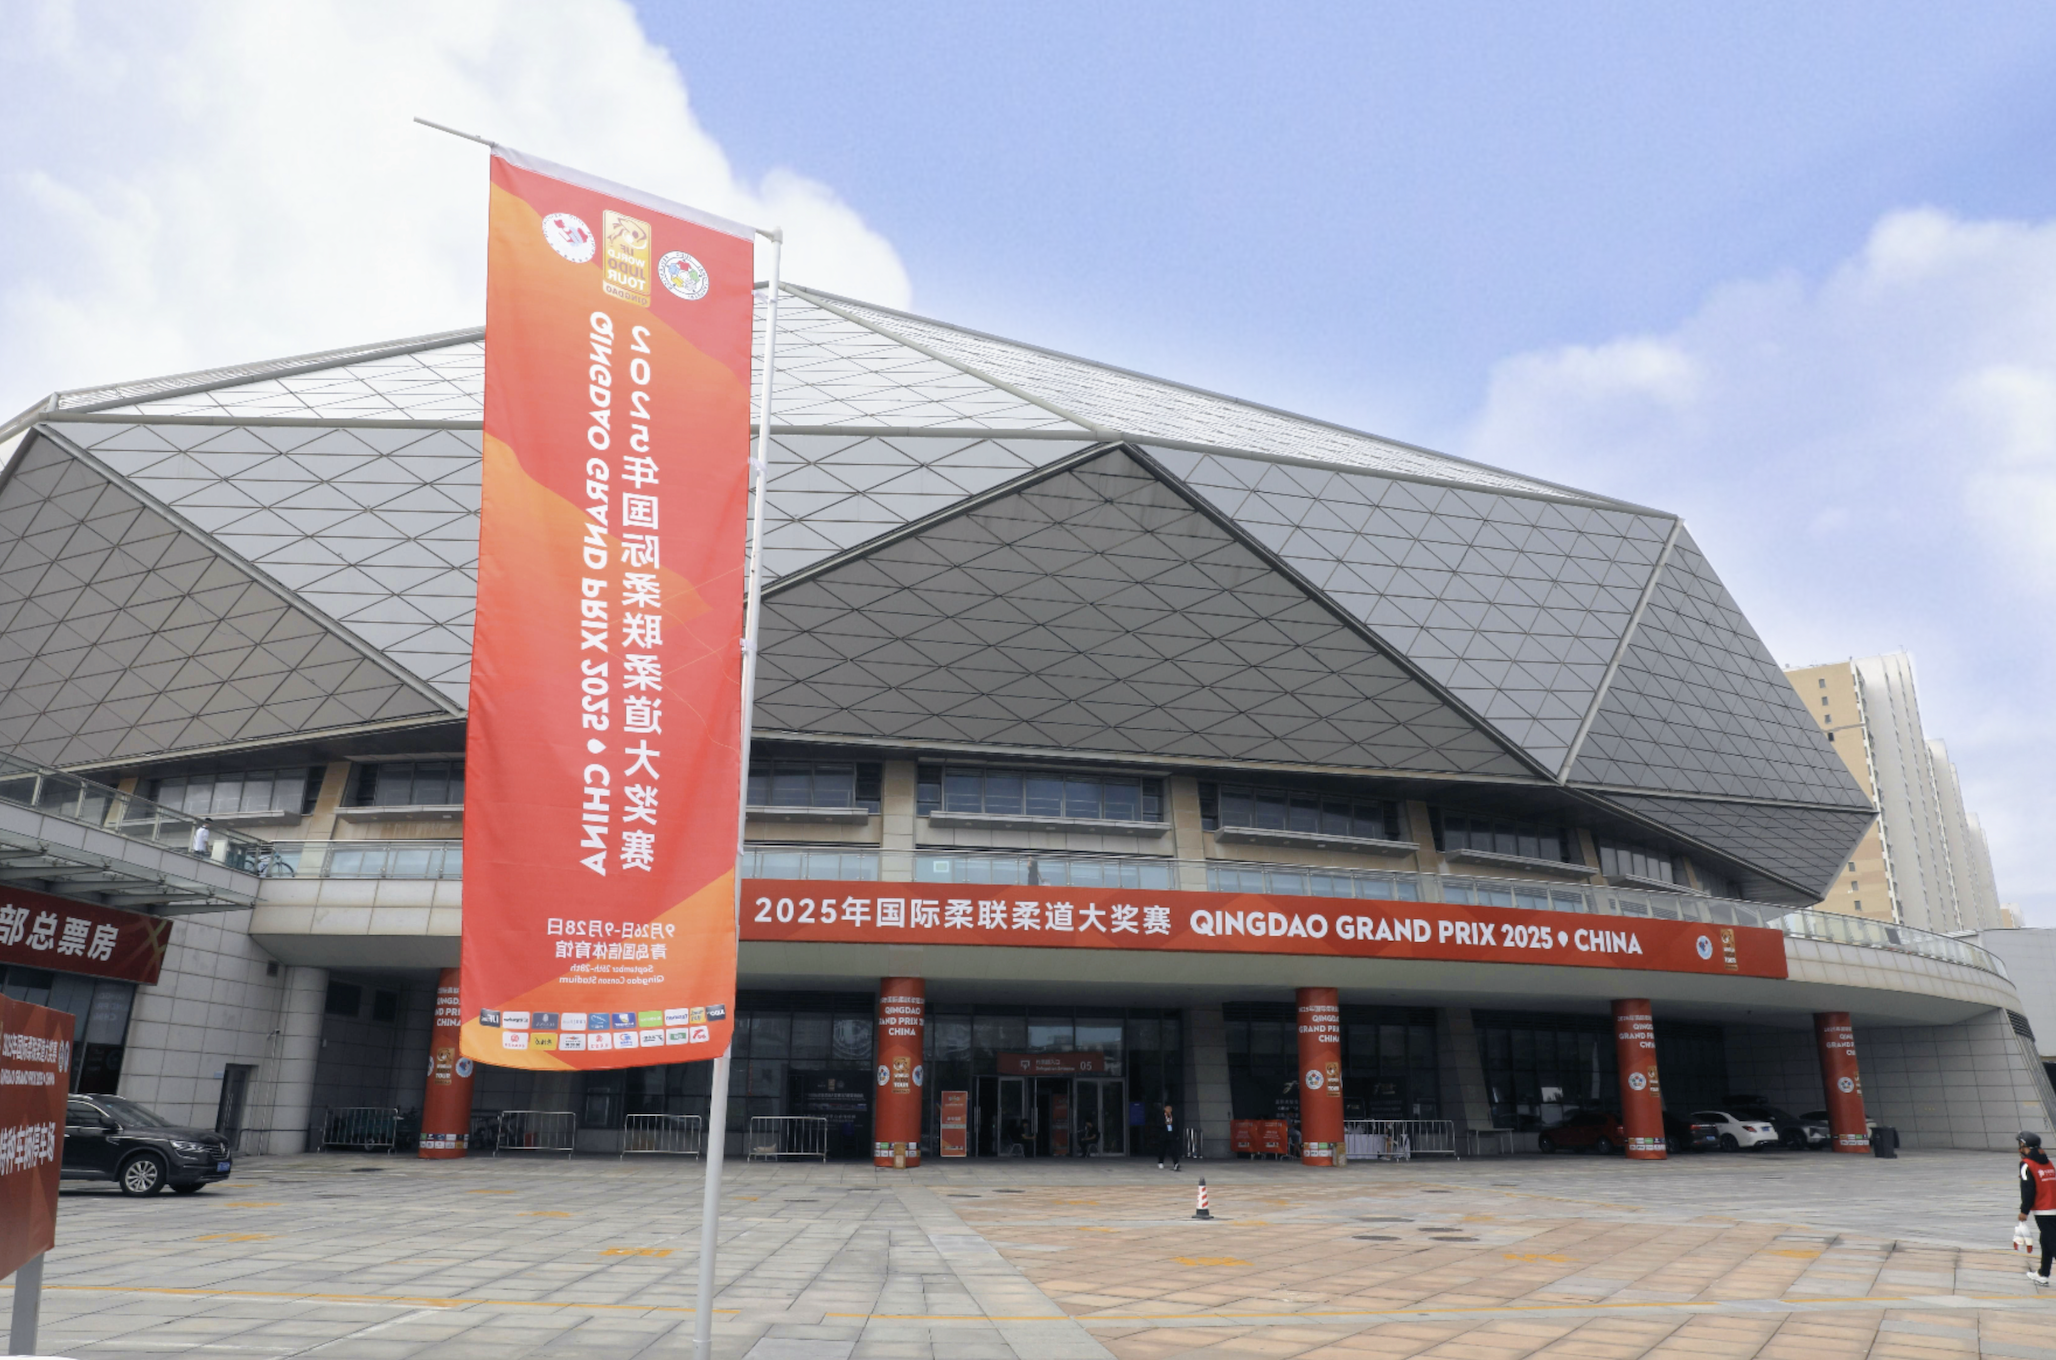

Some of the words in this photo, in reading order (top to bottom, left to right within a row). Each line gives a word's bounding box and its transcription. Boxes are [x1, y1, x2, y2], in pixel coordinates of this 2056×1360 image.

[0, 903, 119, 961] 部总票房
[754, 895, 1172, 936] 2025年国际柔联柔道大奖赛
[1190, 909, 1328, 939] QINGDAO
[1336, 915, 1432, 943] GRAND
[1438, 920, 1497, 946] PRIX
[1501, 923, 1553, 949] 2025
[1574, 928, 1643, 955] CHINA
[888, 1027, 916, 1035] CHINA
[1080, 1061, 1093, 1071] 05
